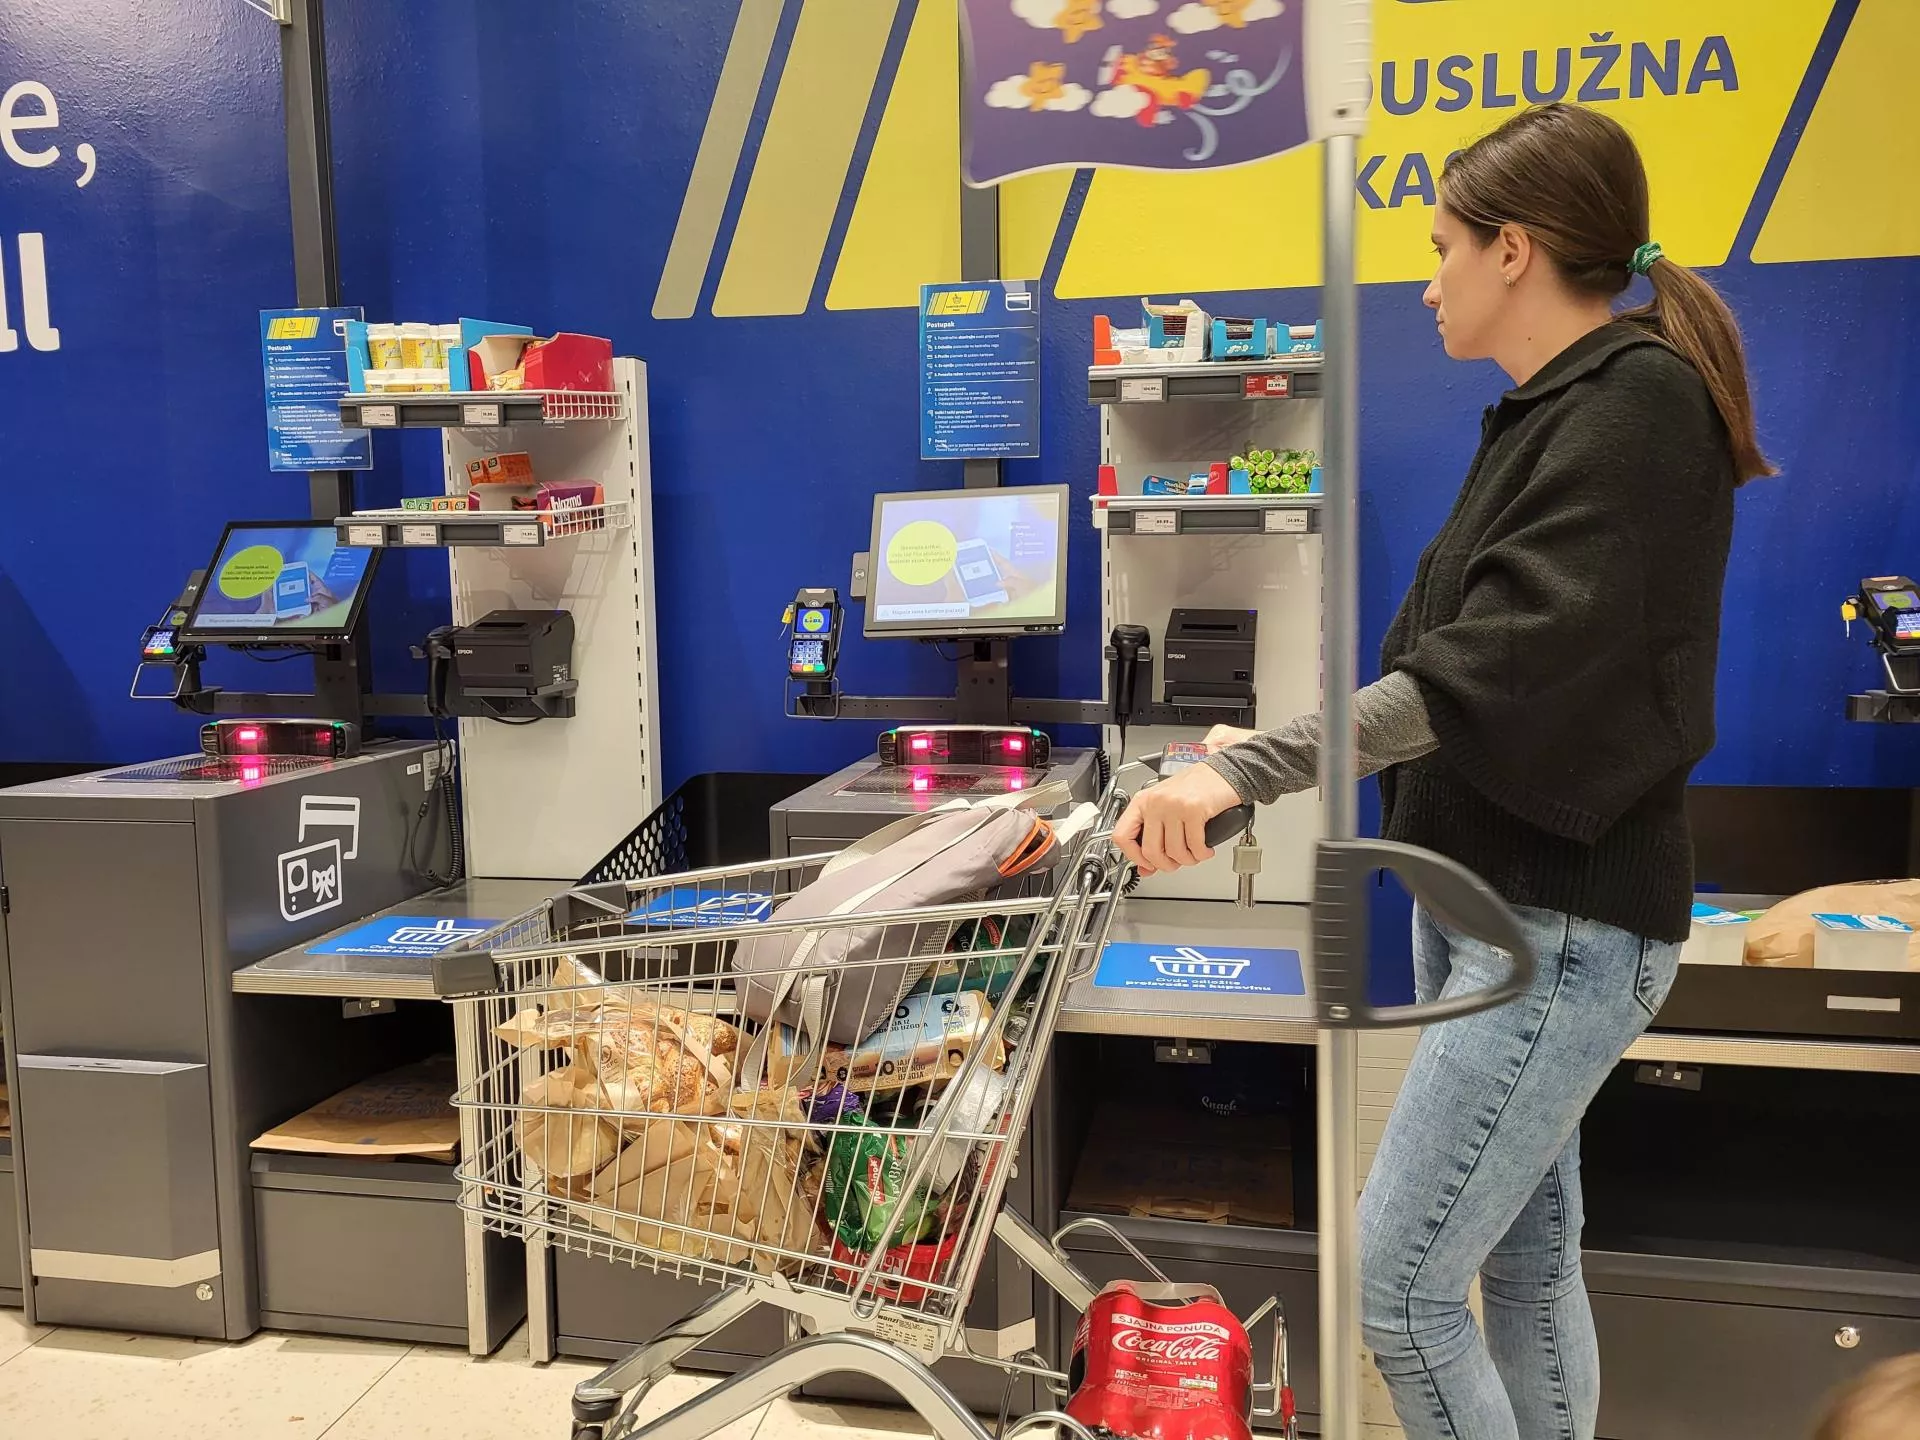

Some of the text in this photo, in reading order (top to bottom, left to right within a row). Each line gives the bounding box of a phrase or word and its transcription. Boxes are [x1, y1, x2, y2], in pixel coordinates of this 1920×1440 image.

[1365, 31, 1739, 116] USLUŽNA
[1354, 150, 1466, 210] KA
[927, 321, 955, 330] Postupak
[1125, 980, 1189, 988] proizvode
[1208, 982, 1271, 992] kupovinu
[1156, 976, 1241, 986] Ovde odložite
[1201, 1095, 1236, 1111] Snack
[1118, 1314, 1221, 1334] SJAJNA PONUDA
[1135, 1356, 1173, 1365] ORIGINAL
[1115, 1368, 1149, 1379] RECYCLE
